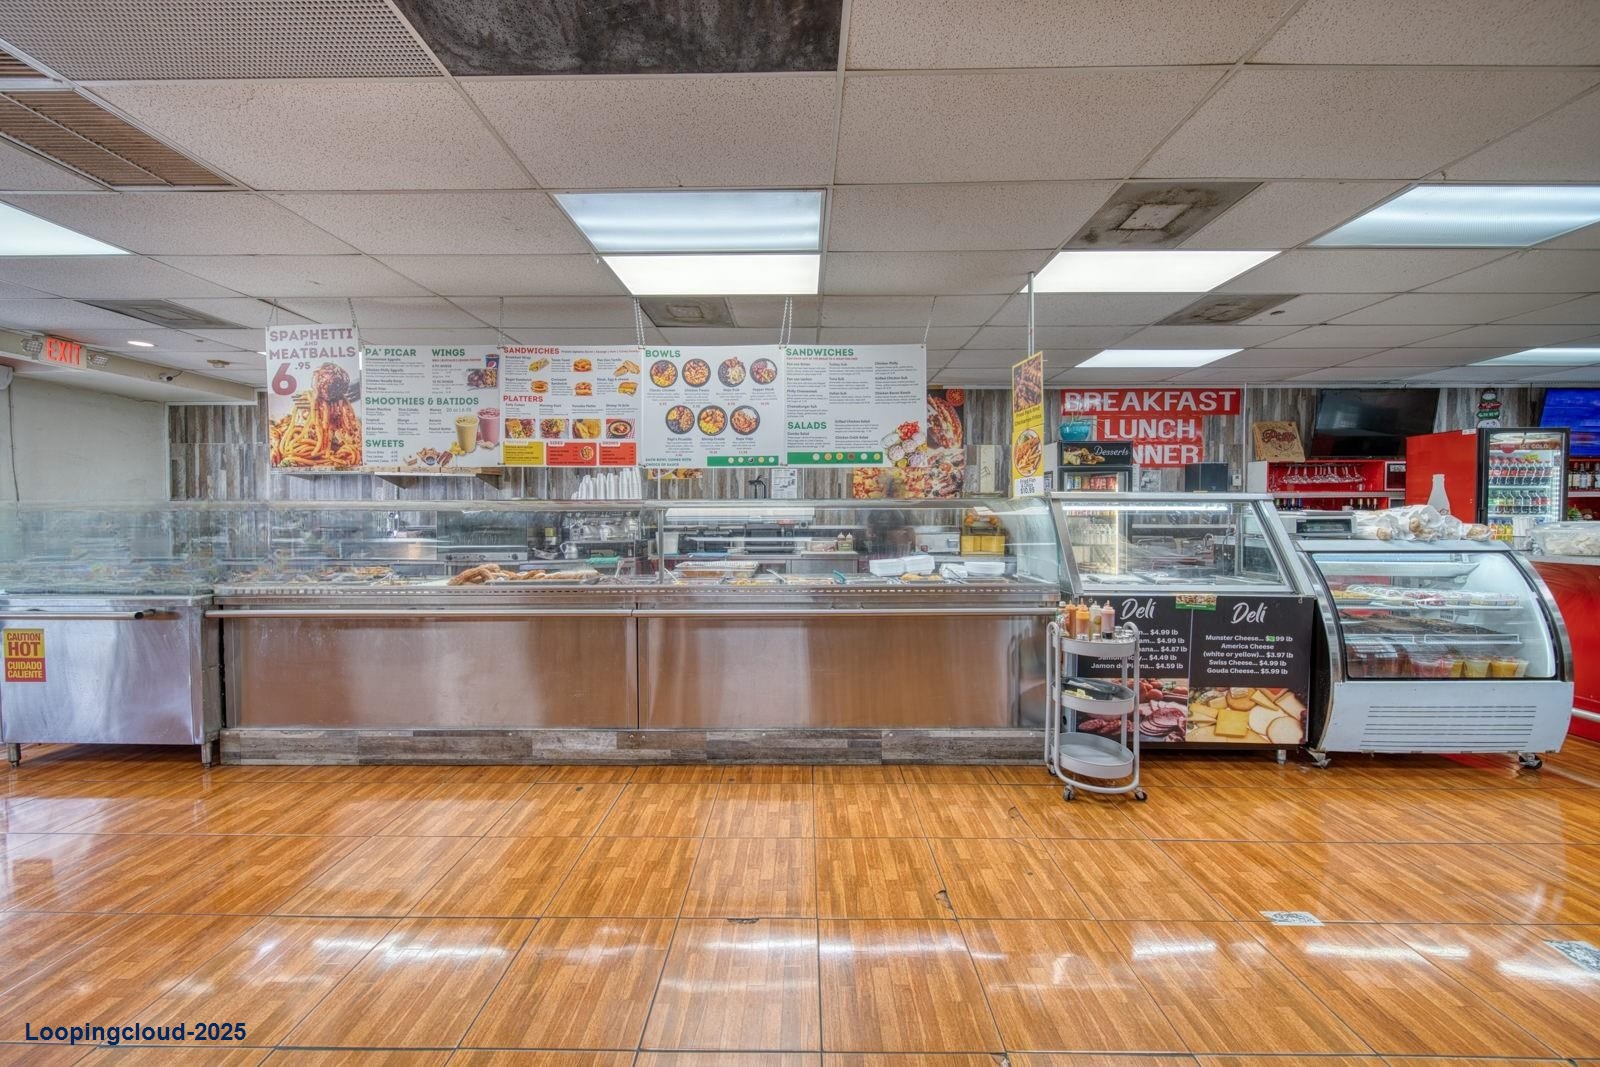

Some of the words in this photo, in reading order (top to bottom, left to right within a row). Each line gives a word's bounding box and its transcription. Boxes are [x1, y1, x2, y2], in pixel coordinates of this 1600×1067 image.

[47, 337, 80, 365] EXIT
[269, 346, 356, 360] MEATBALLS
[384, 349, 417, 357] PICAR
[432, 349, 465, 357] WINGS
[786, 348, 854, 356] SANDWICHES
[365, 397, 425, 405] SMOOTHIES
[427, 397, 434, 405] &
[436, 397, 479, 405] BATIDOS
[1064, 391, 1237, 412] BREAKFAST
[787, 421, 827, 430] SALADS
[1104, 418, 1195, 439] LUNCH
[1094, 446, 1129, 456] Desserts
[1133, 444, 1198, 464] NNER
[1120, 598, 1157, 620] Deli
[1230, 602, 1268, 624] Deli
[7, 632, 41, 641] CAUTION
[8, 641, 41, 657] HOT
[8, 661, 42, 670] CUIDADO
[8, 670, 43, 679] CALIENTE
